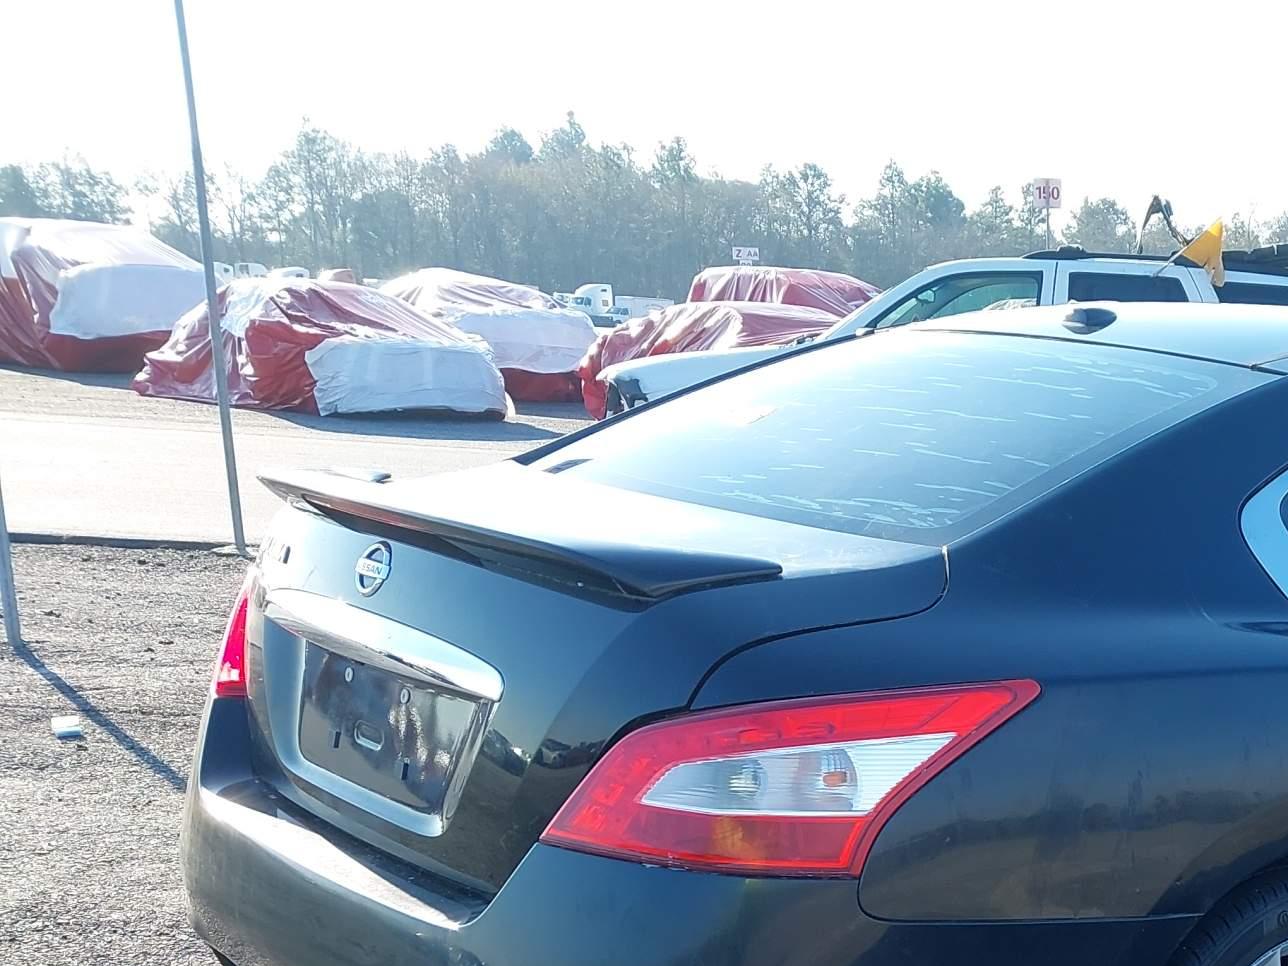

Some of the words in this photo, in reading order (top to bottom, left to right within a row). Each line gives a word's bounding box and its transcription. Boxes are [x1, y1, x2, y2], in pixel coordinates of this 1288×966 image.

[1035, 186, 1060, 200] 150
[735, 249, 742, 258] Z
[747, 249, 758, 257] AA
